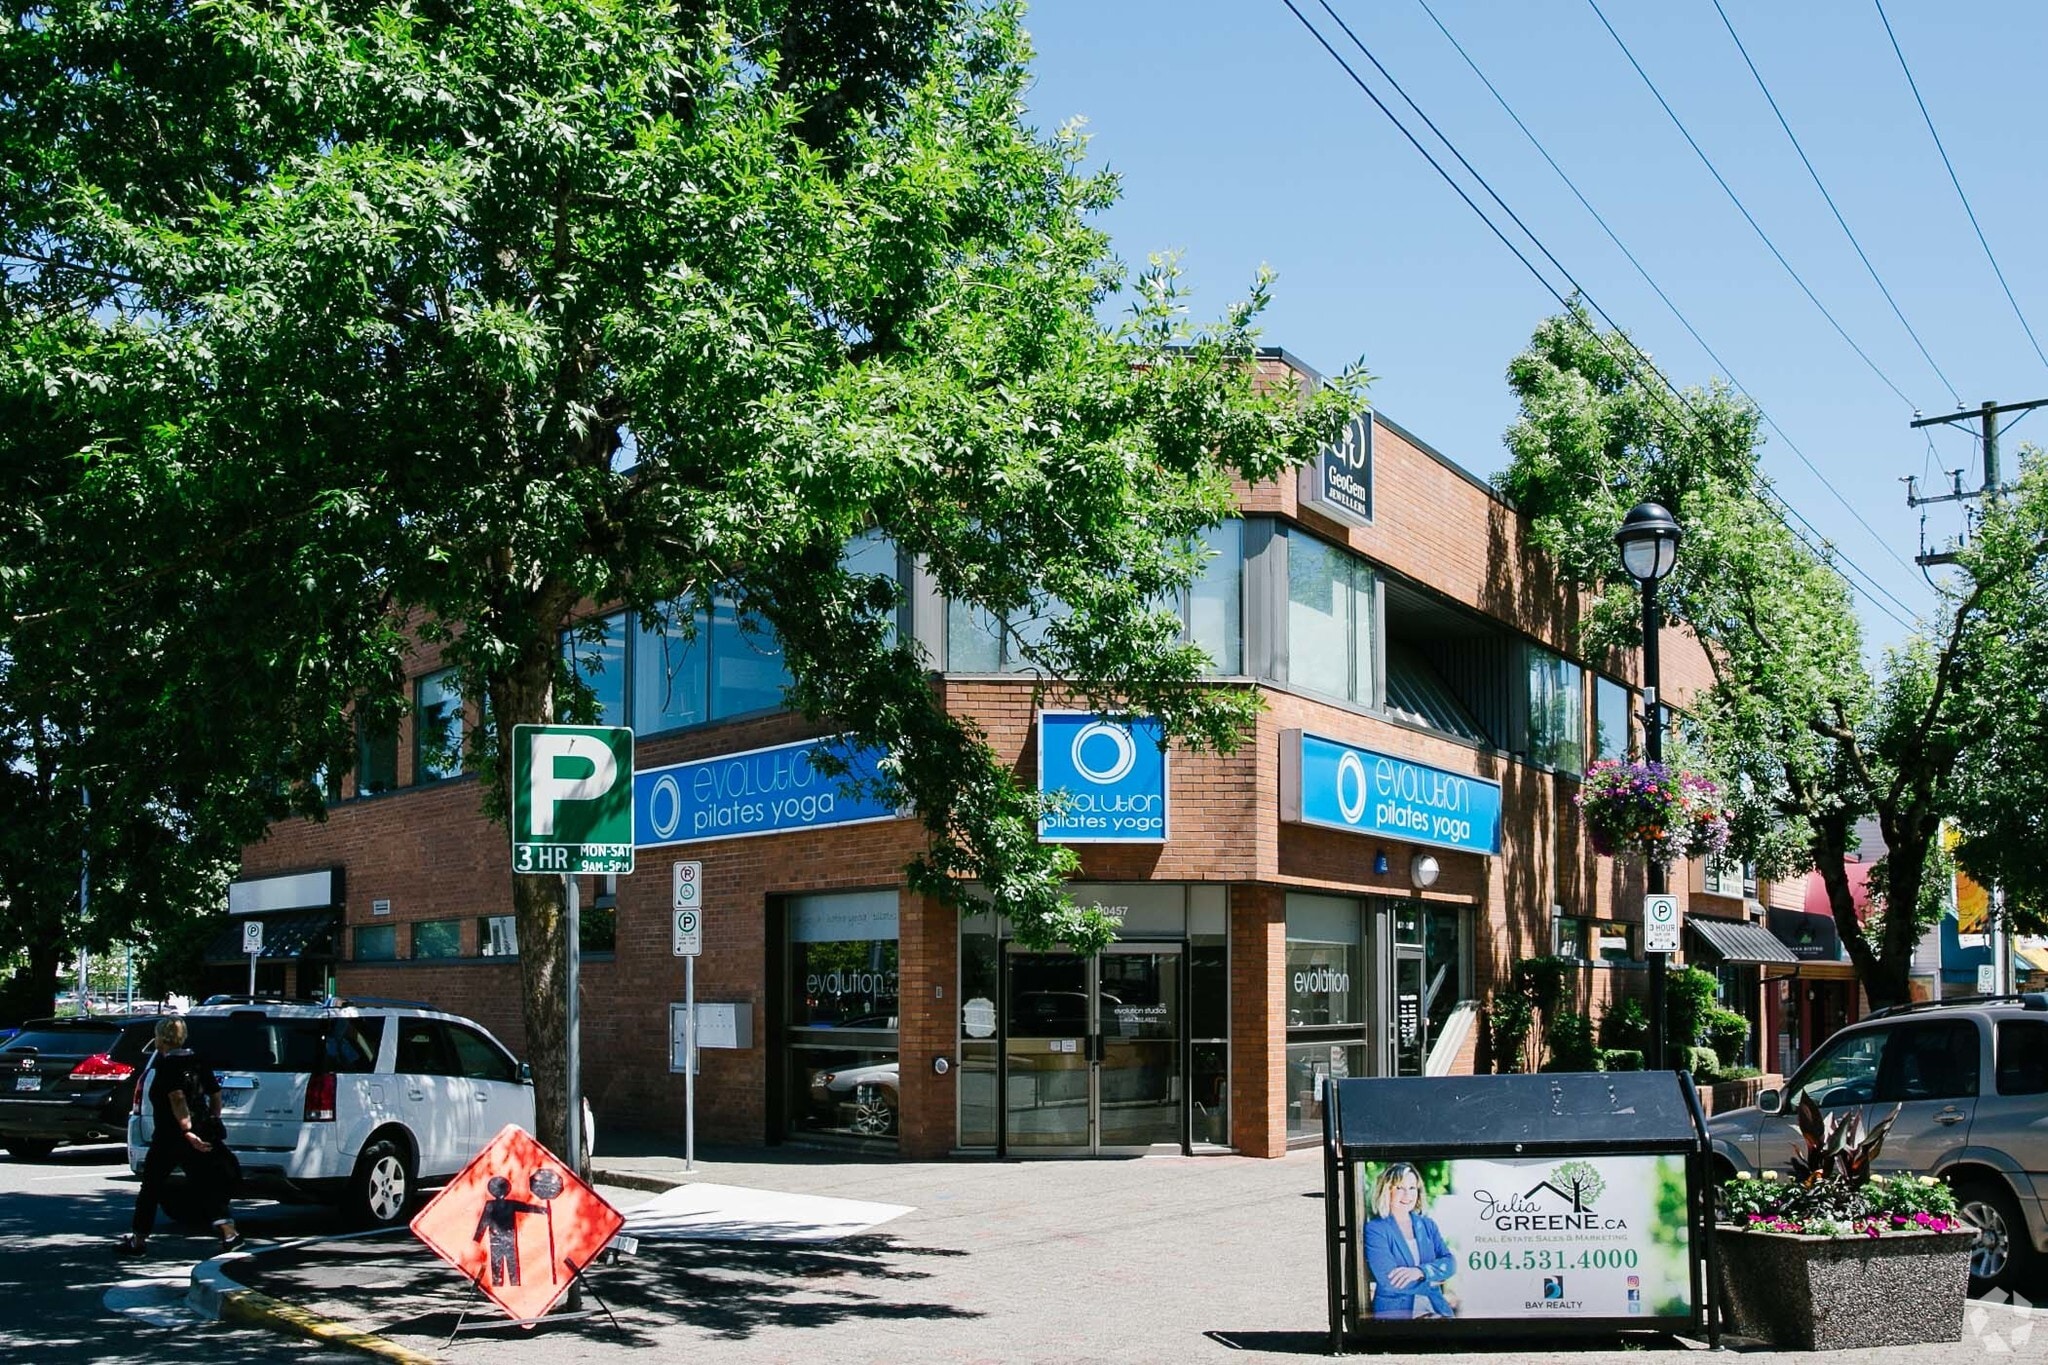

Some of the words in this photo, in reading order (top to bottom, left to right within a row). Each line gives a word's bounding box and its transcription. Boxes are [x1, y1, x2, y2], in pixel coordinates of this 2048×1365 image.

[1328, 465, 1366, 501] GeoGem
[1329, 487, 1366, 515] JEWELLERS
[531, 734, 617, 835] P
[694, 802, 764, 834] pilates
[771, 793, 834, 826] yoga
[1043, 813, 1107, 831] pilates
[1112, 817, 1163, 832] yoga
[1376, 800, 1428, 832] pilates
[1433, 814, 1470, 843] yoga
[517, 845, 533, 870] 3
[539, 847, 568, 869] HR
[580, 845, 631, 857] MON-SAT
[581, 860, 630, 872] 9AM-5PM
[683, 917, 693, 929] P
[1658, 905, 1668, 917] P
[1656, 924, 1676, 932] HOUR
[806, 968, 883, 994] evolution
[1294, 968, 1350, 993] evolution
[1114, 1007, 1143, 1015] evolution
[1473, 1189, 1541, 1221] Julia
[1468, 1248, 1638, 1271] 604.531.4000
[1525, 1301, 1543, 1309] BAY
[1546, 1301, 1583, 1309] REALTY
